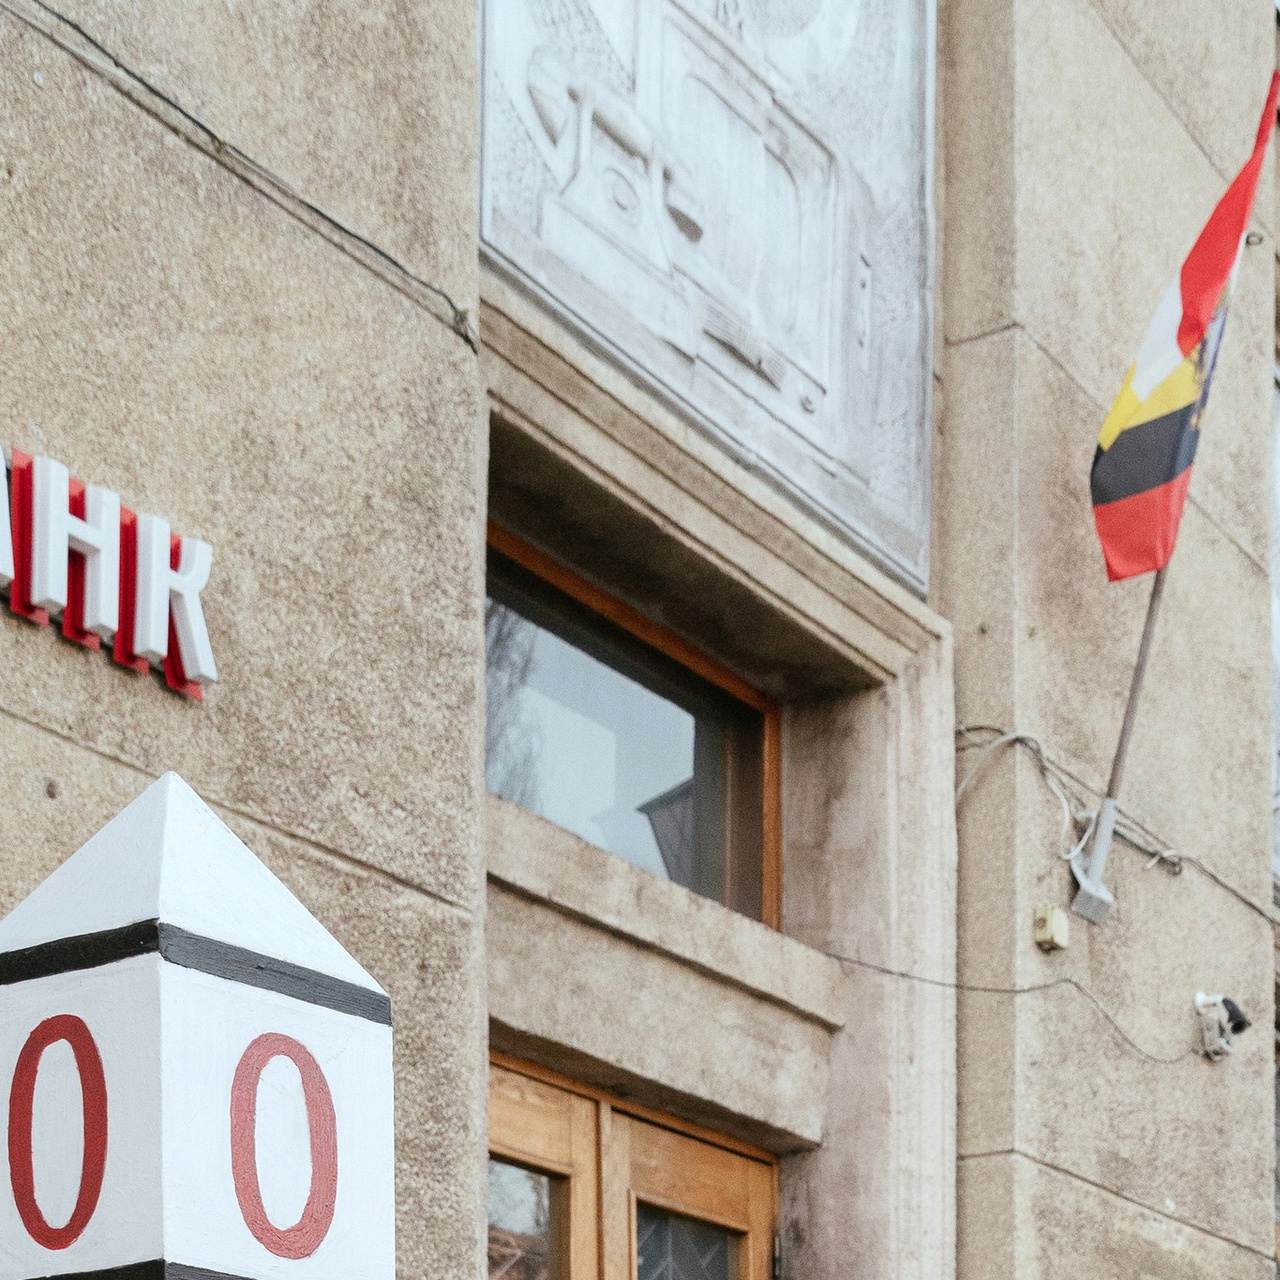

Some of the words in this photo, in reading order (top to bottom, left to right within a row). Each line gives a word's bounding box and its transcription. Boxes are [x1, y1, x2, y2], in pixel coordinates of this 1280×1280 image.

[0, 446, 218, 700] НК
[8, 1014, 108, 1250] 0
[230, 1032, 338, 1260] 0
